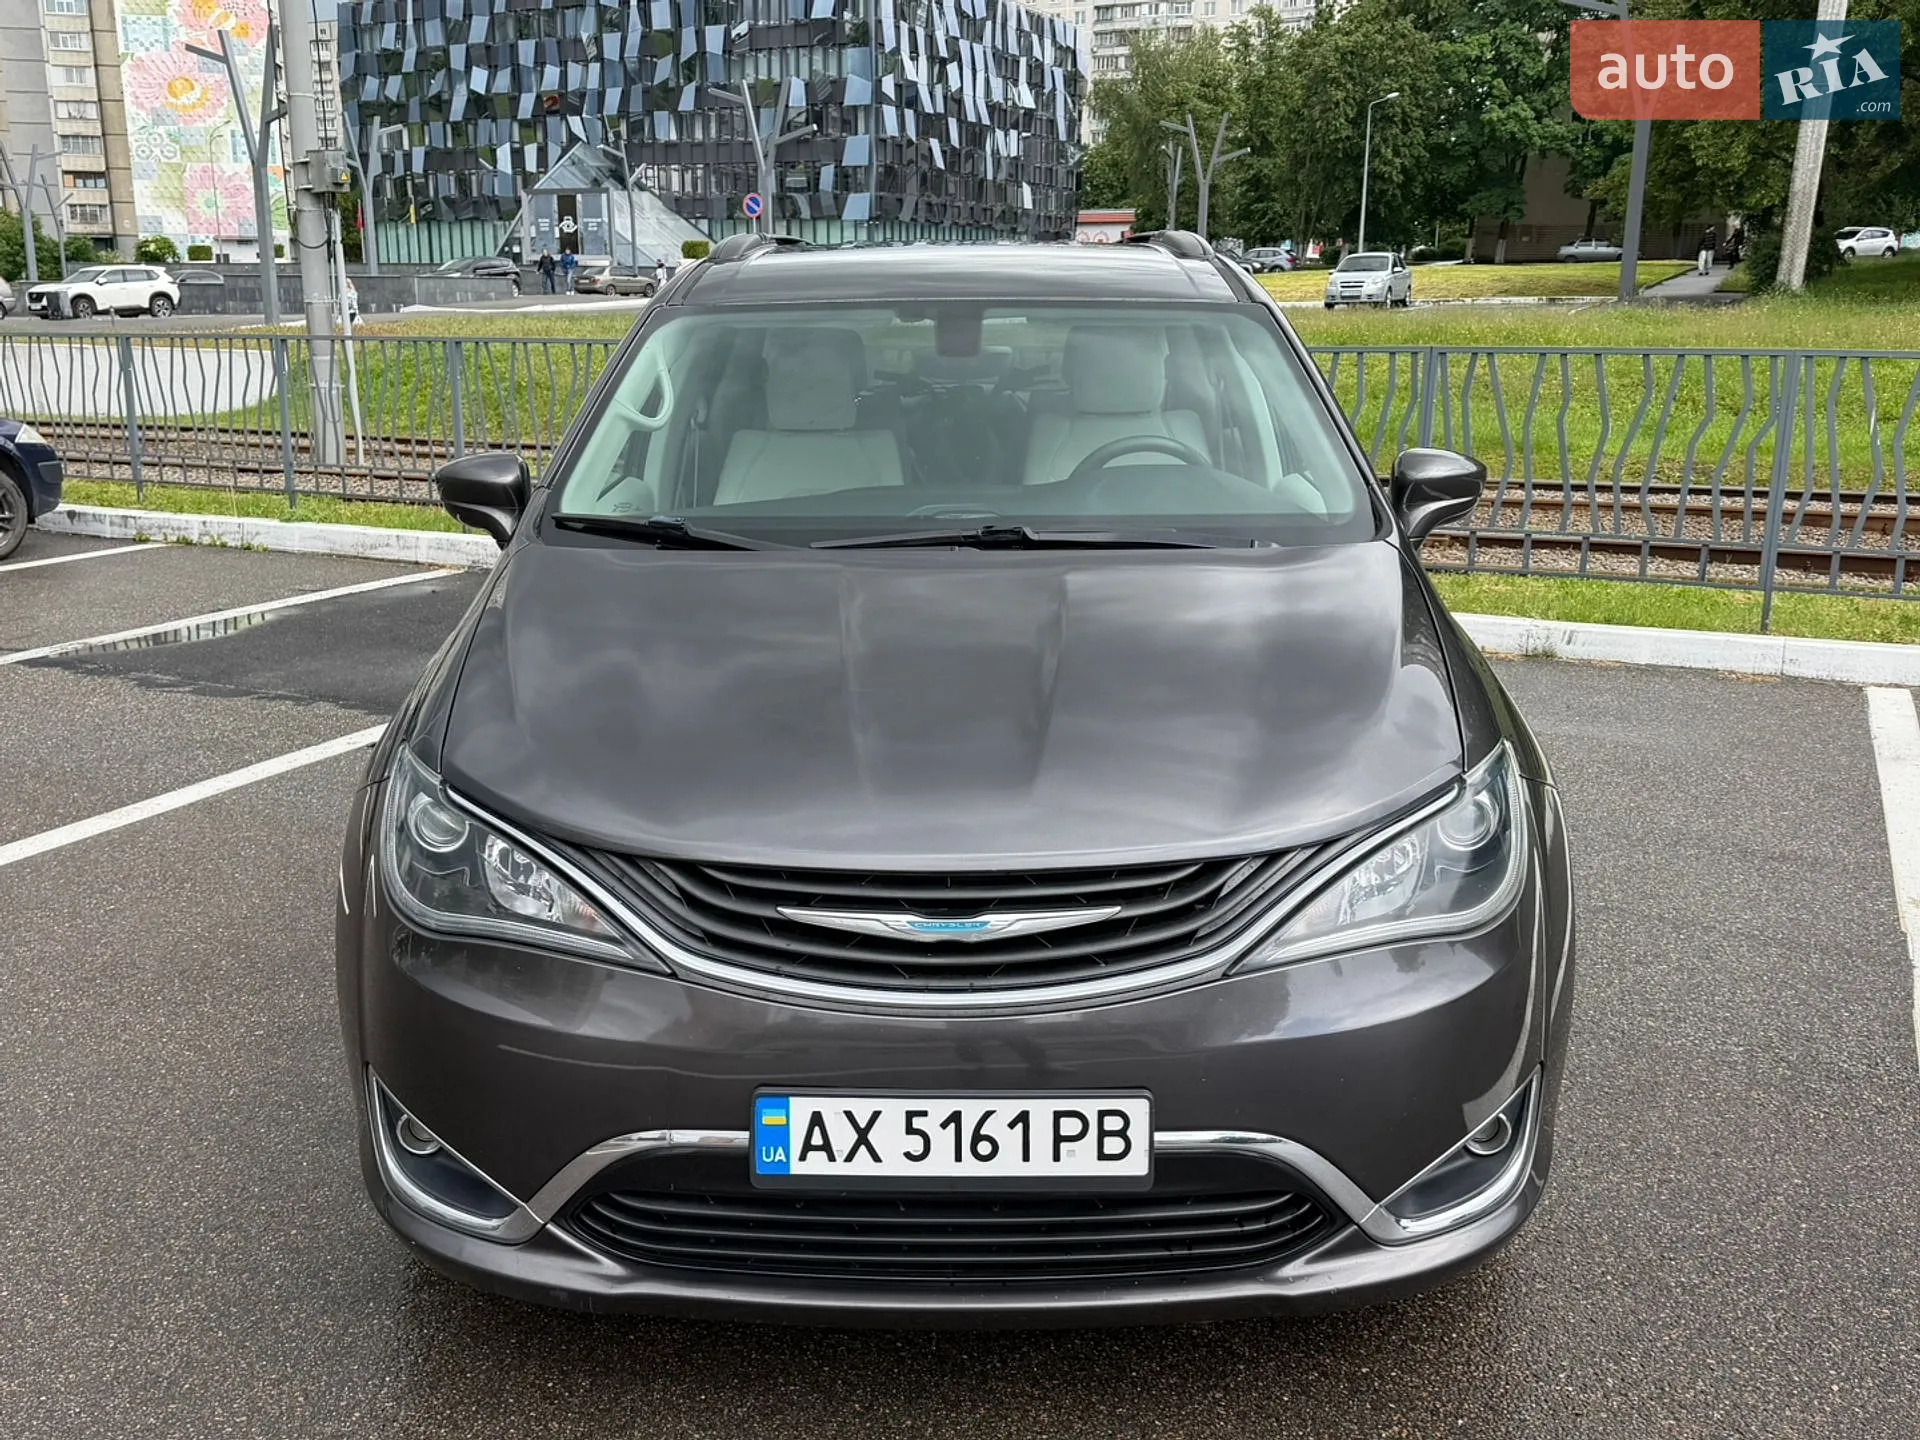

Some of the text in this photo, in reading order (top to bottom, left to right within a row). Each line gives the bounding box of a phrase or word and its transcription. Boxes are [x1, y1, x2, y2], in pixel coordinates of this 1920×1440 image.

[797, 1109, 1133, 1164] AX 5161 PB
[761, 1146, 788, 1164] UA
